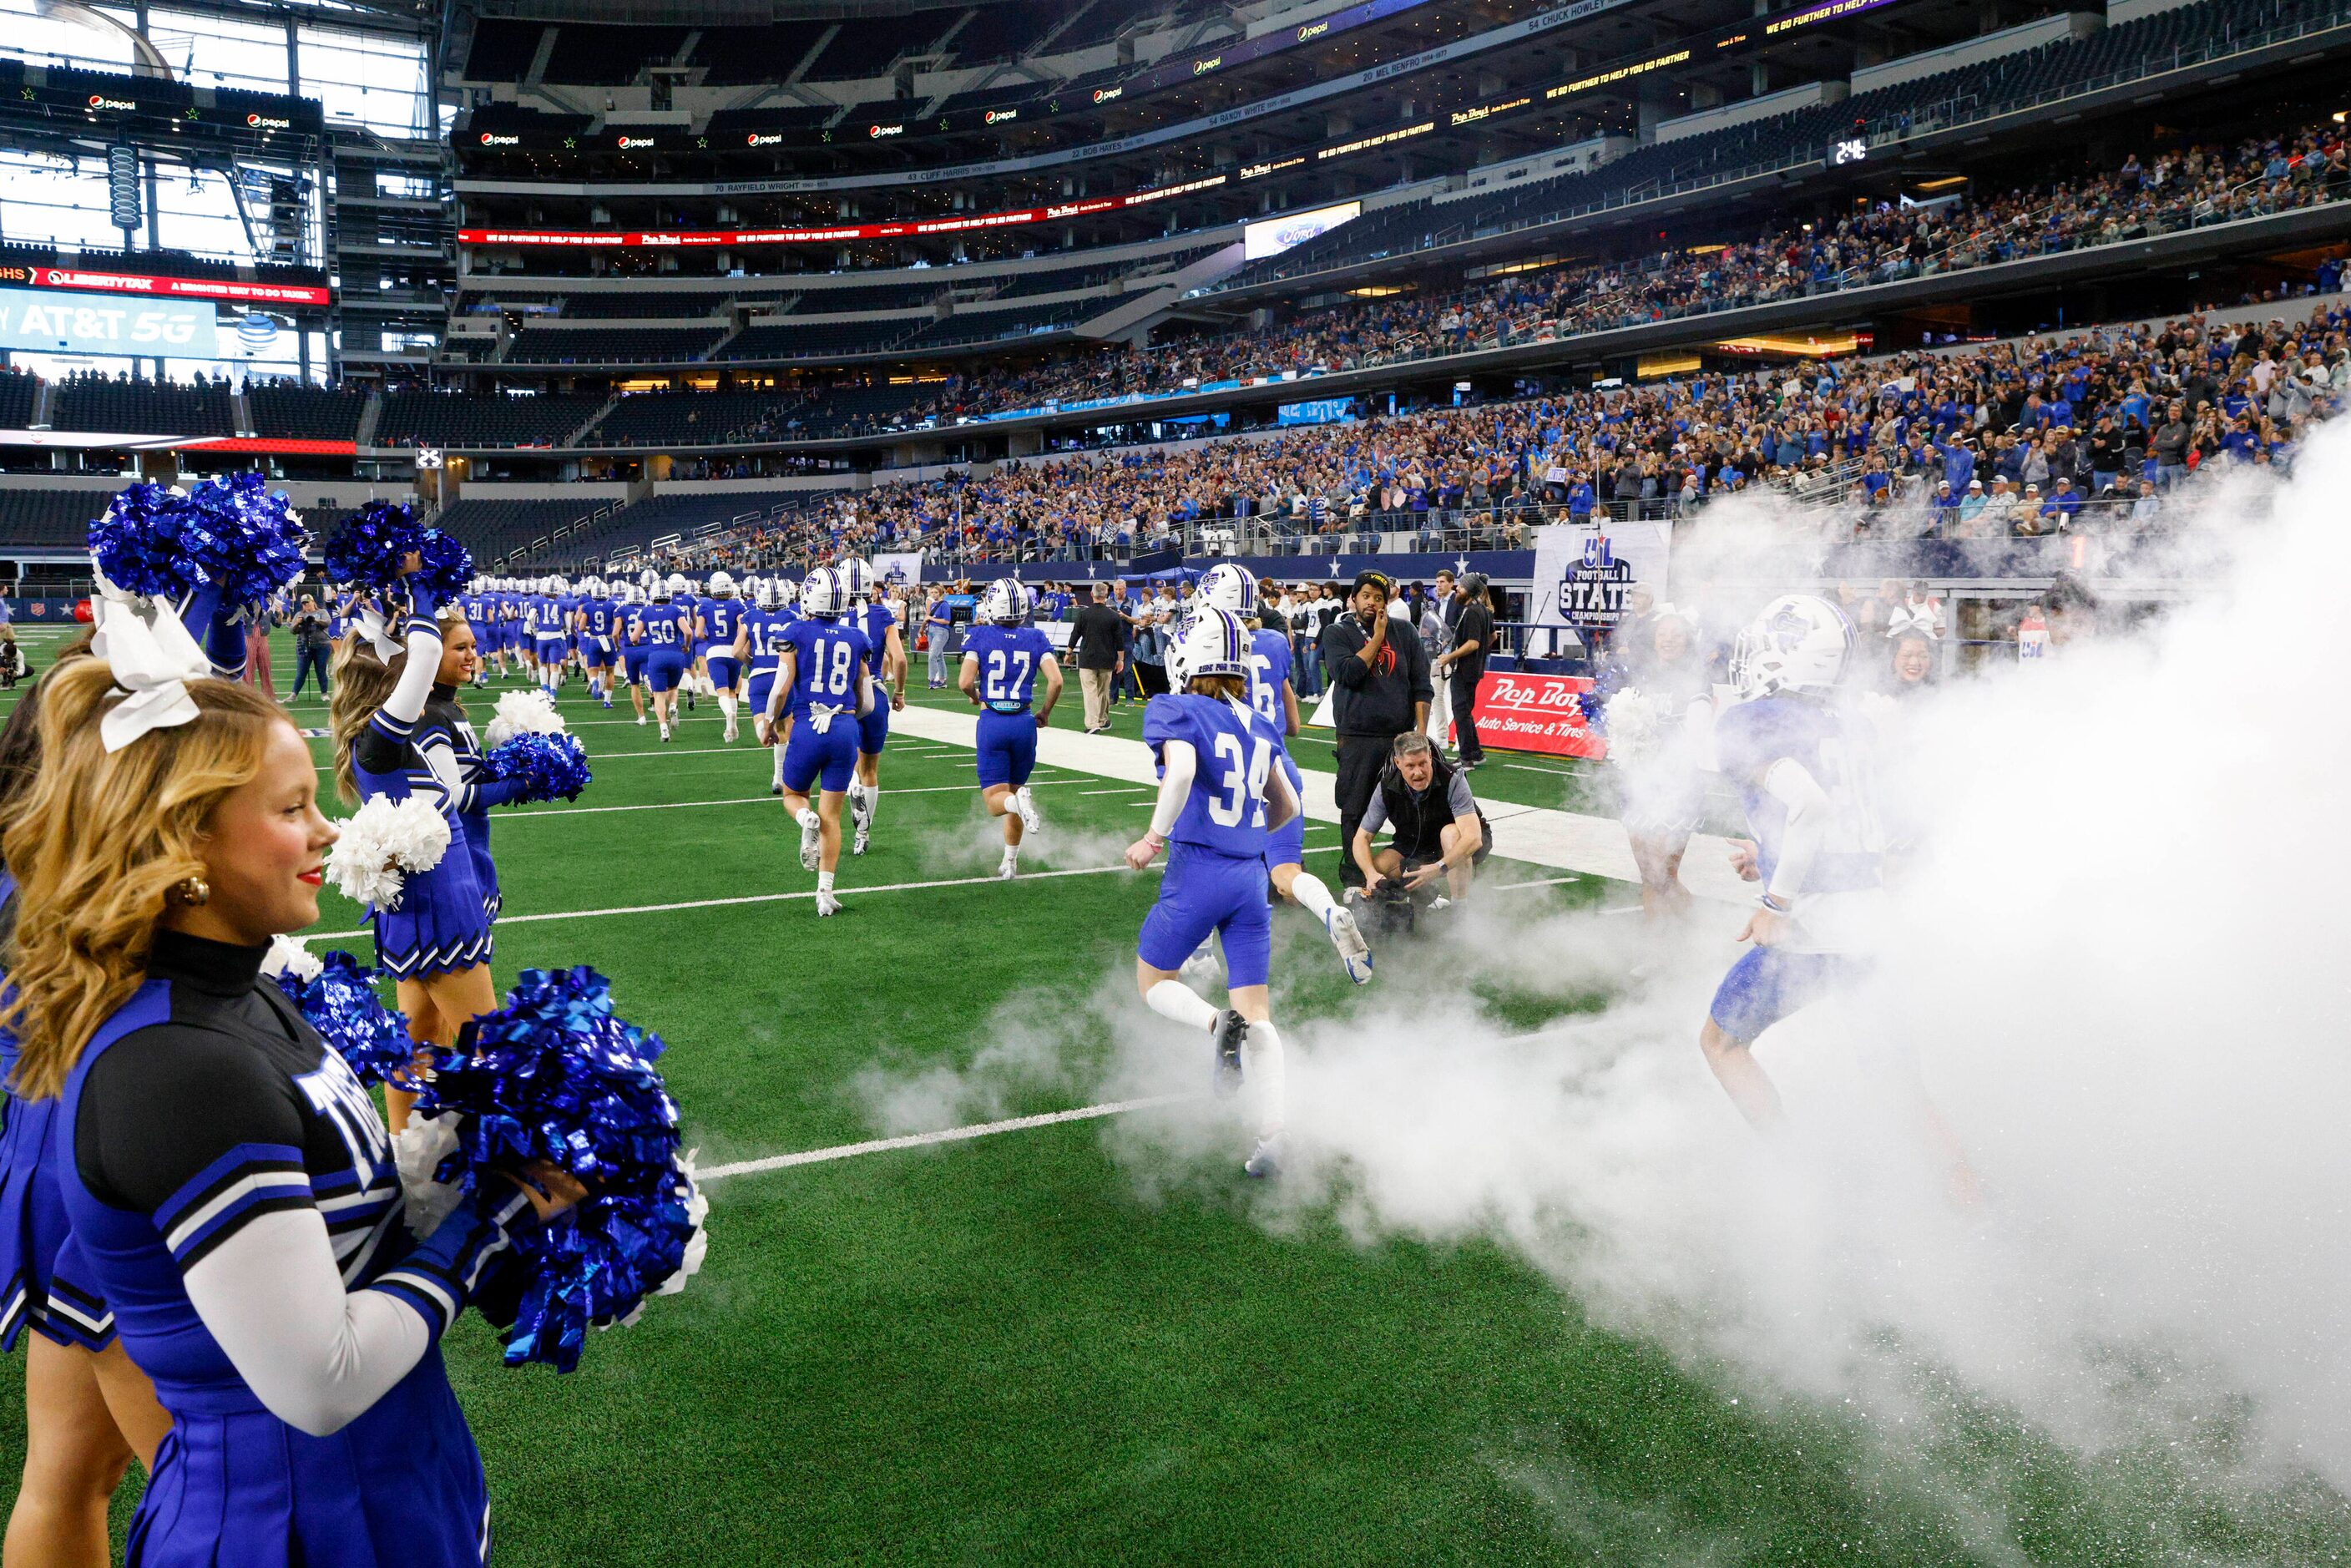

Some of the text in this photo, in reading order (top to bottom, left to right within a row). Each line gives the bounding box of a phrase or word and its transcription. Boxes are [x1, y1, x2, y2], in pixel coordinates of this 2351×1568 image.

[1529, 0, 1604, 30] 54 CHUCK HOWLEY
[1767, 0, 1867, 34] WE GO FURTHER TO HELP
[1307, 22, 1327, 38] pepsi
[1203, 56, 1221, 71] pepsi
[1363, 58, 1419, 82] 20 MEL RENFRO
[1547, 51, 1690, 99] WE GO FURTHER TO HELP YOU GO FARTHER
[1104, 87, 1122, 100] pepsi
[105, 99, 135, 110] pepsi
[1220, 109, 1242, 122] RANDY
[1244, 104, 1265, 115] WHITE
[262, 119, 289, 129] pepsi
[996, 109, 1017, 121] pepsi
[494, 135, 518, 145] pepsi
[760, 134, 781, 144] pepsi
[881, 124, 902, 136] pepsi
[630, 138, 654, 147] pepsi
[1083, 146, 1098, 155] BOB
[1099, 143, 1122, 153] HAYES
[1318, 150, 1327, 159] WE
[1337, 142, 1363, 154] FURTHER
[1363, 139, 1372, 148] TO
[1371, 135, 1386, 145] HELP
[1386, 132, 1398, 141] YOU
[1398, 129, 1408, 139] GO
[1408, 123, 1434, 136] FARTHER
[921, 170, 940, 180] CLIFF
[943, 167, 969, 176] HARRIS
[728, 183, 766, 191] RAYFIELD
[768, 182, 800, 190] WRIGHT
[1143, 190, 1164, 201] FURTHER
[1170, 185, 1185, 195] HELP
[1185, 183, 1195, 191] YOU
[1203, 176, 1226, 187] FARTHER
[1284, 222, 1317, 244] Ford
[0, 267, 25, 280] HS
[171, 282, 180, 291] A
[180, 283, 228, 294] BRIGHTER
[229, 286, 250, 295] WAY
[250, 287, 265, 296] TO
[265, 288, 281, 297] DO
[19, 305, 127, 340] AT&T
[130, 311, 198, 343] 5G
[417, 449, 442, 468] 25
[1583, 538, 1615, 569] UIL
[1576, 569, 1619, 581] FOOTBALL
[1560, 582, 1634, 609] STATE
[468, 602, 483, 620] 31
[543, 604, 559, 625] 14
[594, 610, 605, 632] 9
[648, 620, 675, 644] 50
[714, 609, 727, 637] 5
[752, 622, 781, 656] 12
[810, 638, 852, 695] 18
[987, 650, 1030, 700] 27
[1216, 663, 1227, 671] FOR
[1231, 664, 1241, 673] THE
[1489, 678, 1584, 718] Pep Boy
[1475, 715, 1586, 740] Auto Service & Tires
[1208, 731, 1272, 828] 34
